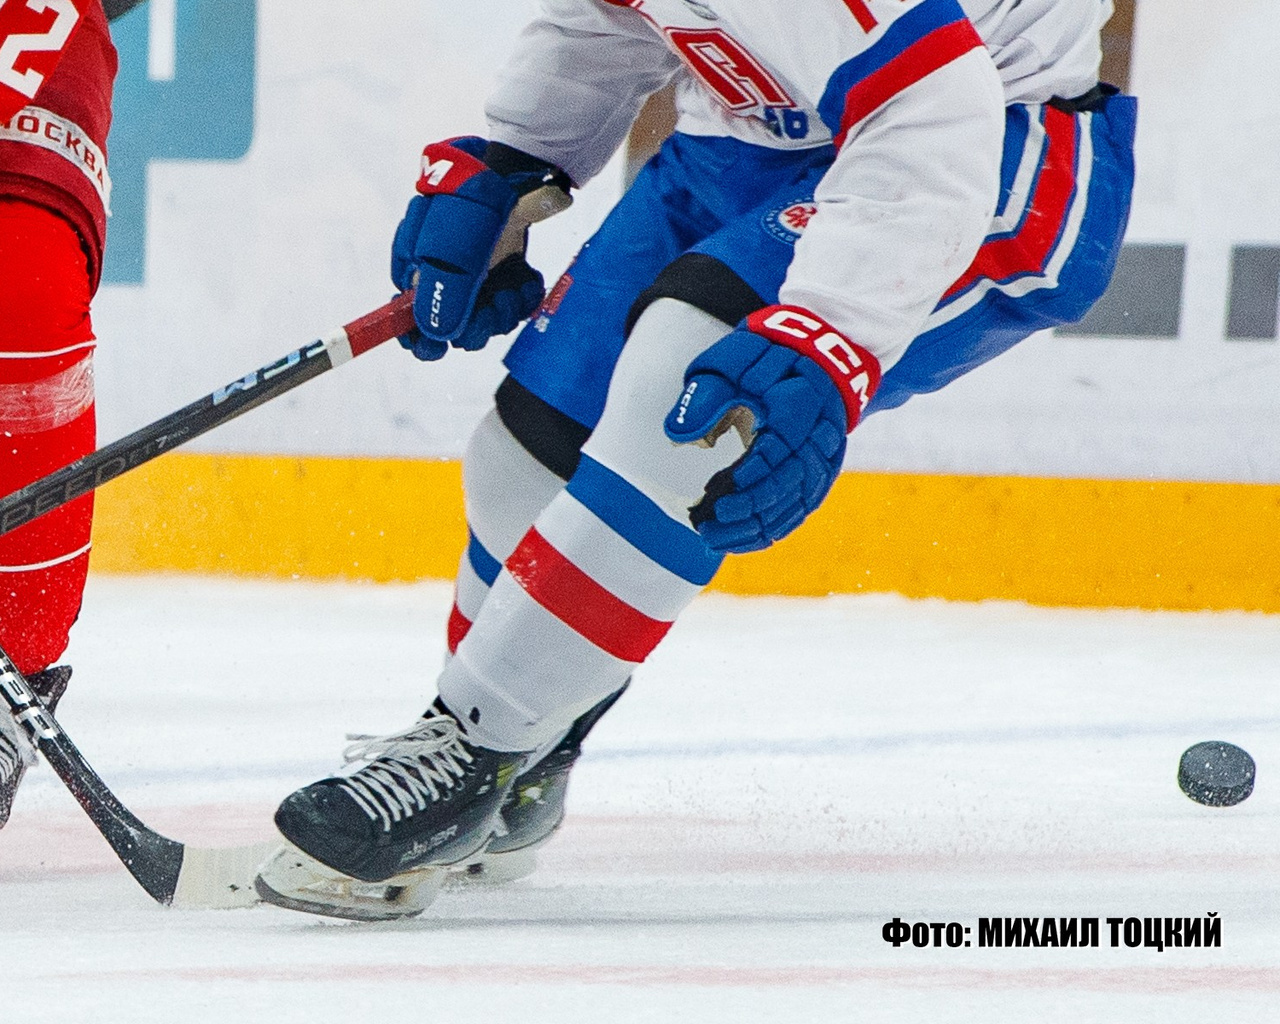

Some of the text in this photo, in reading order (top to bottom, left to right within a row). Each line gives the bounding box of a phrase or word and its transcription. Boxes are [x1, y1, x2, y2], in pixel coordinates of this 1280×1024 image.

[430, 281, 445, 328] CCM
[762, 309, 870, 413] CCM
[676, 381, 698, 424] CCM
